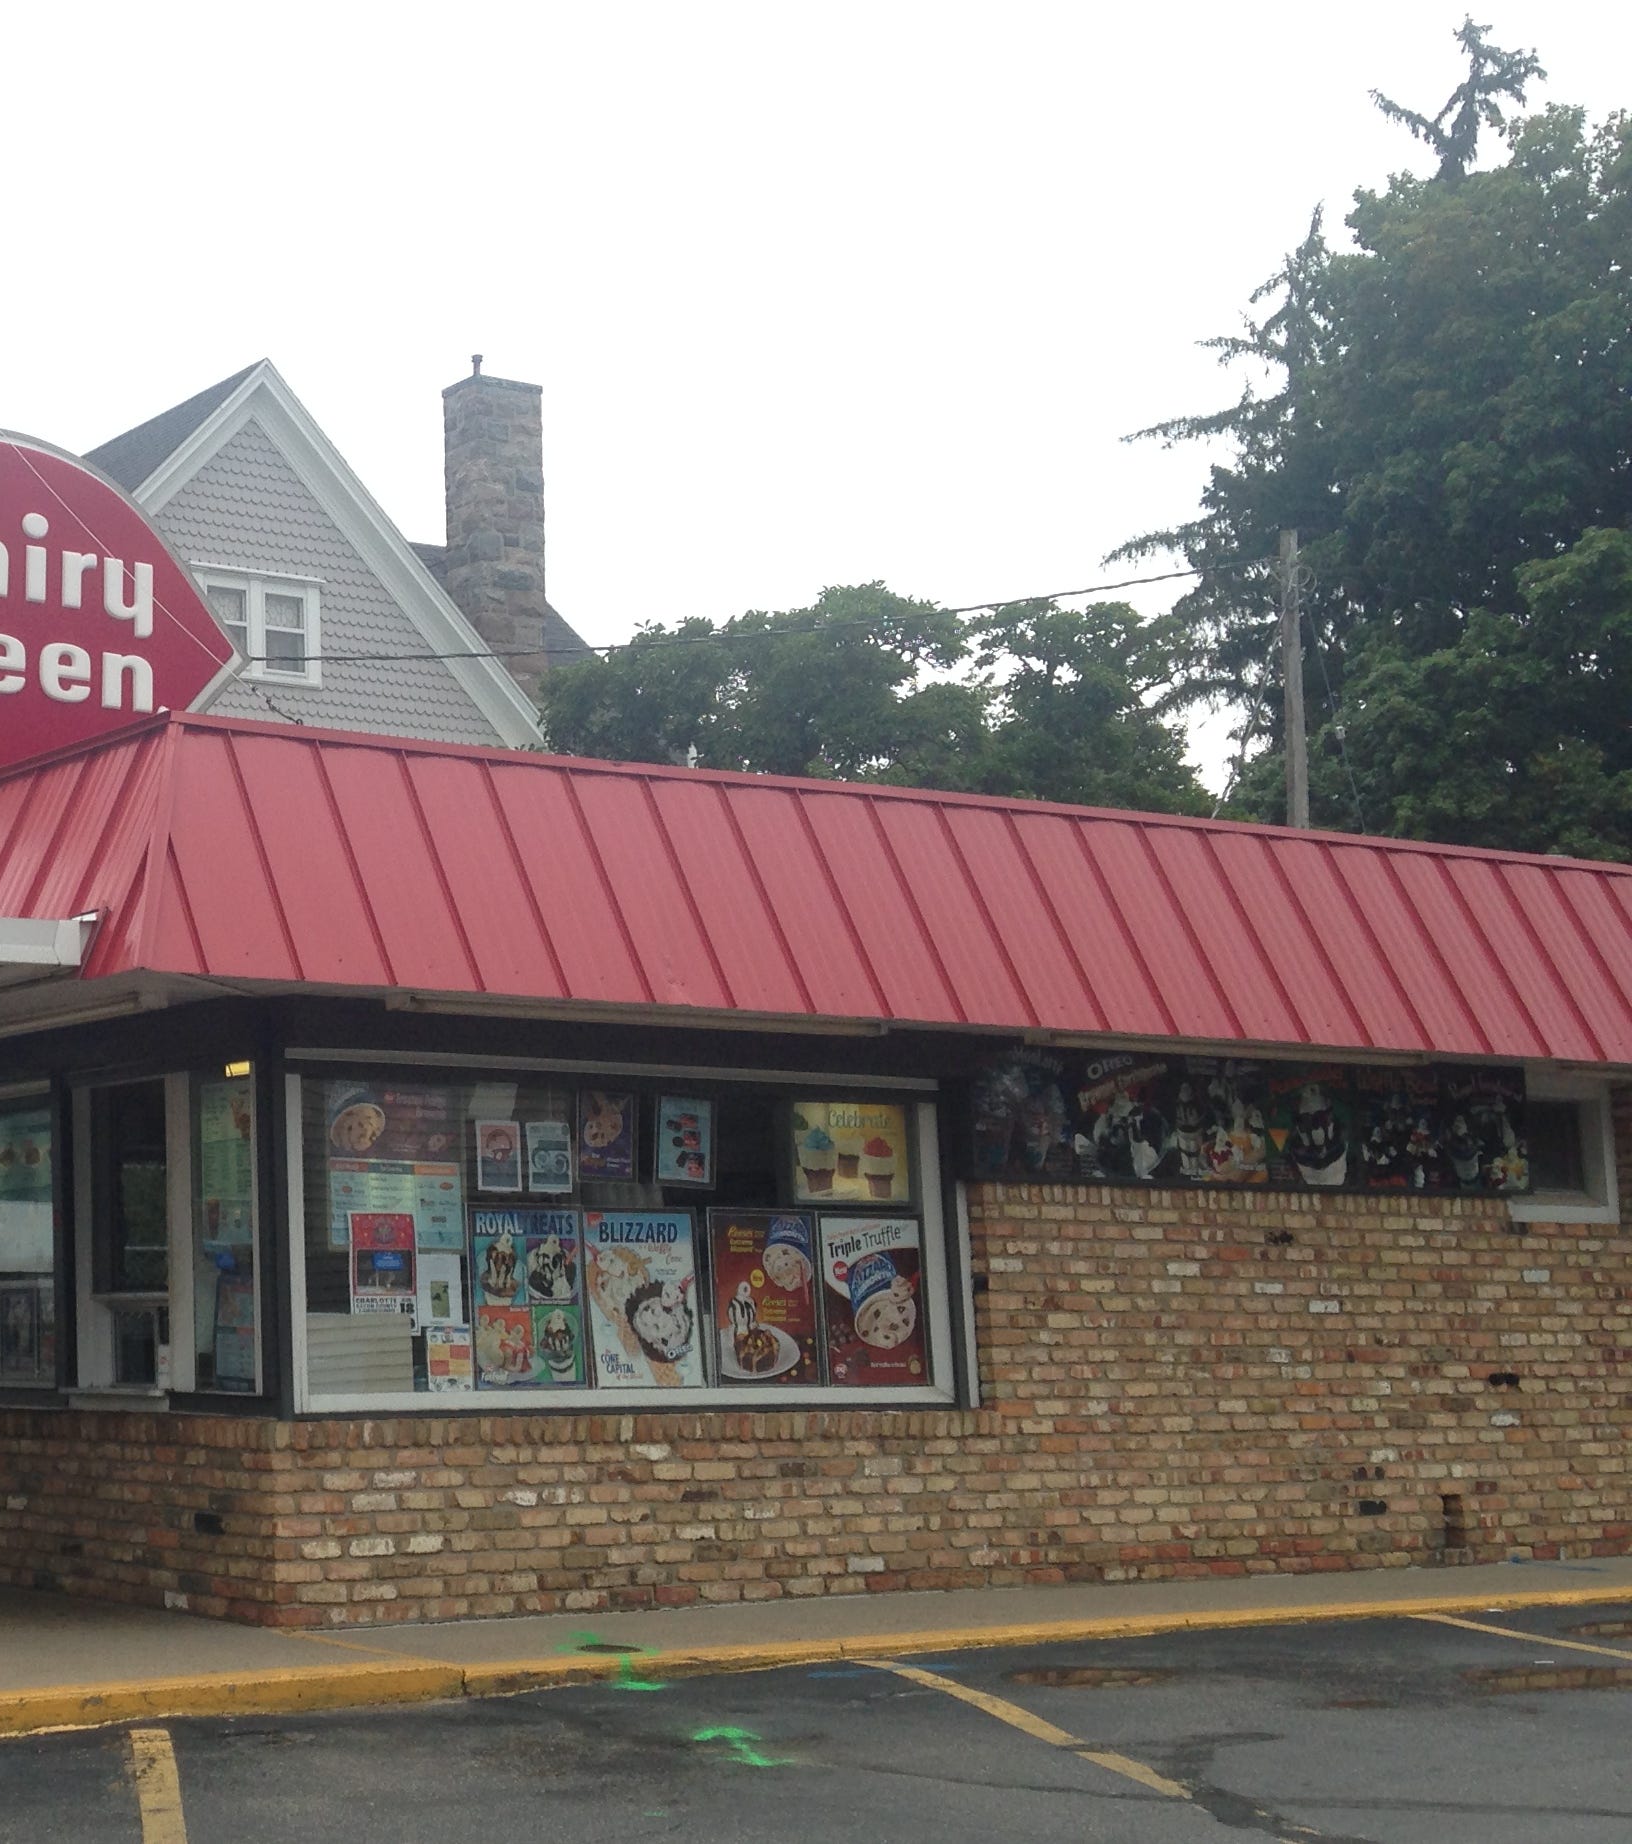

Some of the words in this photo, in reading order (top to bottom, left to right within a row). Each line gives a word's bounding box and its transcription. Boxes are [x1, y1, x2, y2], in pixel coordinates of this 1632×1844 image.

[1087, 1056, 1133, 1081] OREO
[475, 1212, 523, 1235] ROYAL
[599, 1222, 678, 1244] BLIZZARD
[828, 1237, 862, 1259] Triple
[862, 1225, 902, 1249] Truffle
[399, 1302, 415, 1315] 18
